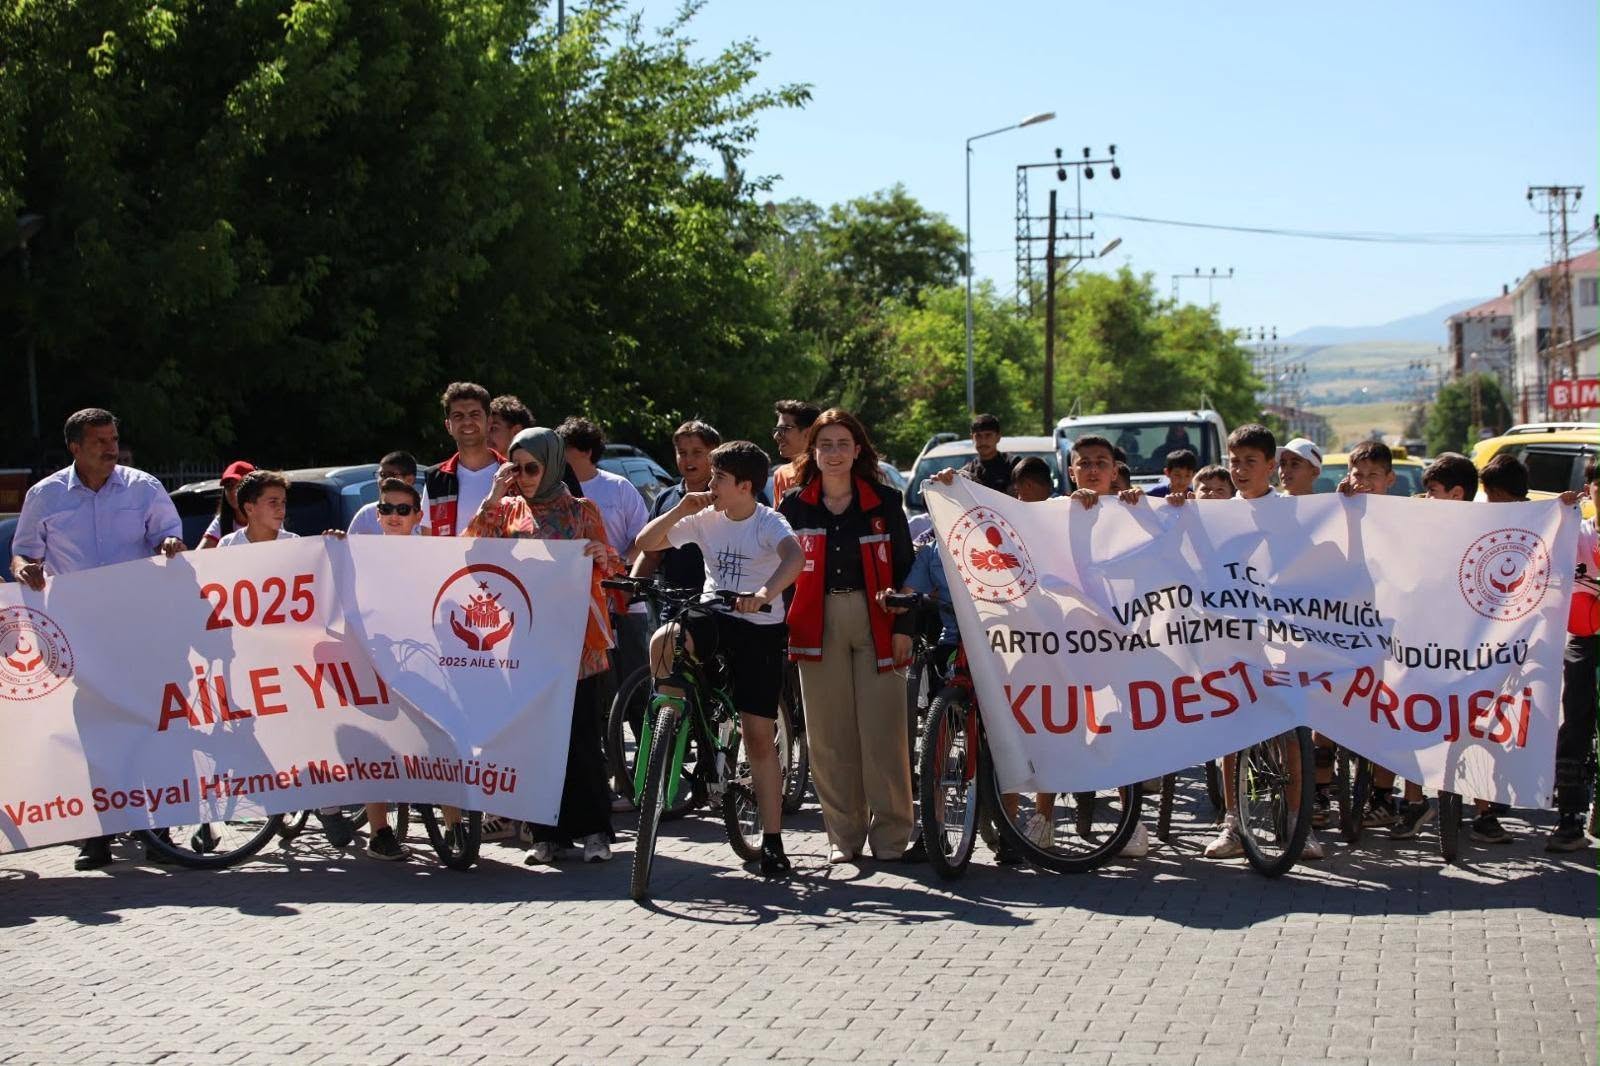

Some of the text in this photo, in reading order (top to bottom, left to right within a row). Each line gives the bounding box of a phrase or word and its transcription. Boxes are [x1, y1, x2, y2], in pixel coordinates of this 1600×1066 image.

[200, 574, 314, 630] 2025
[1223, 562, 1265, 587] T.C.
[1112, 585, 1384, 627] VARTO KAYMAKAMLIĞI
[439, 656, 519, 669] 2025 AİLE YILI
[986, 615, 1529, 672] ARTO SOSYAL HİZMET MERKEZİ MÜDÜRLÜĞÜ
[158, 665, 288, 732] AİLE
[1342, 665, 1532, 748] PROJESİ
[4, 754, 518, 827] Varto Sosyal Hizmet Merkezi Müdürlüğü
